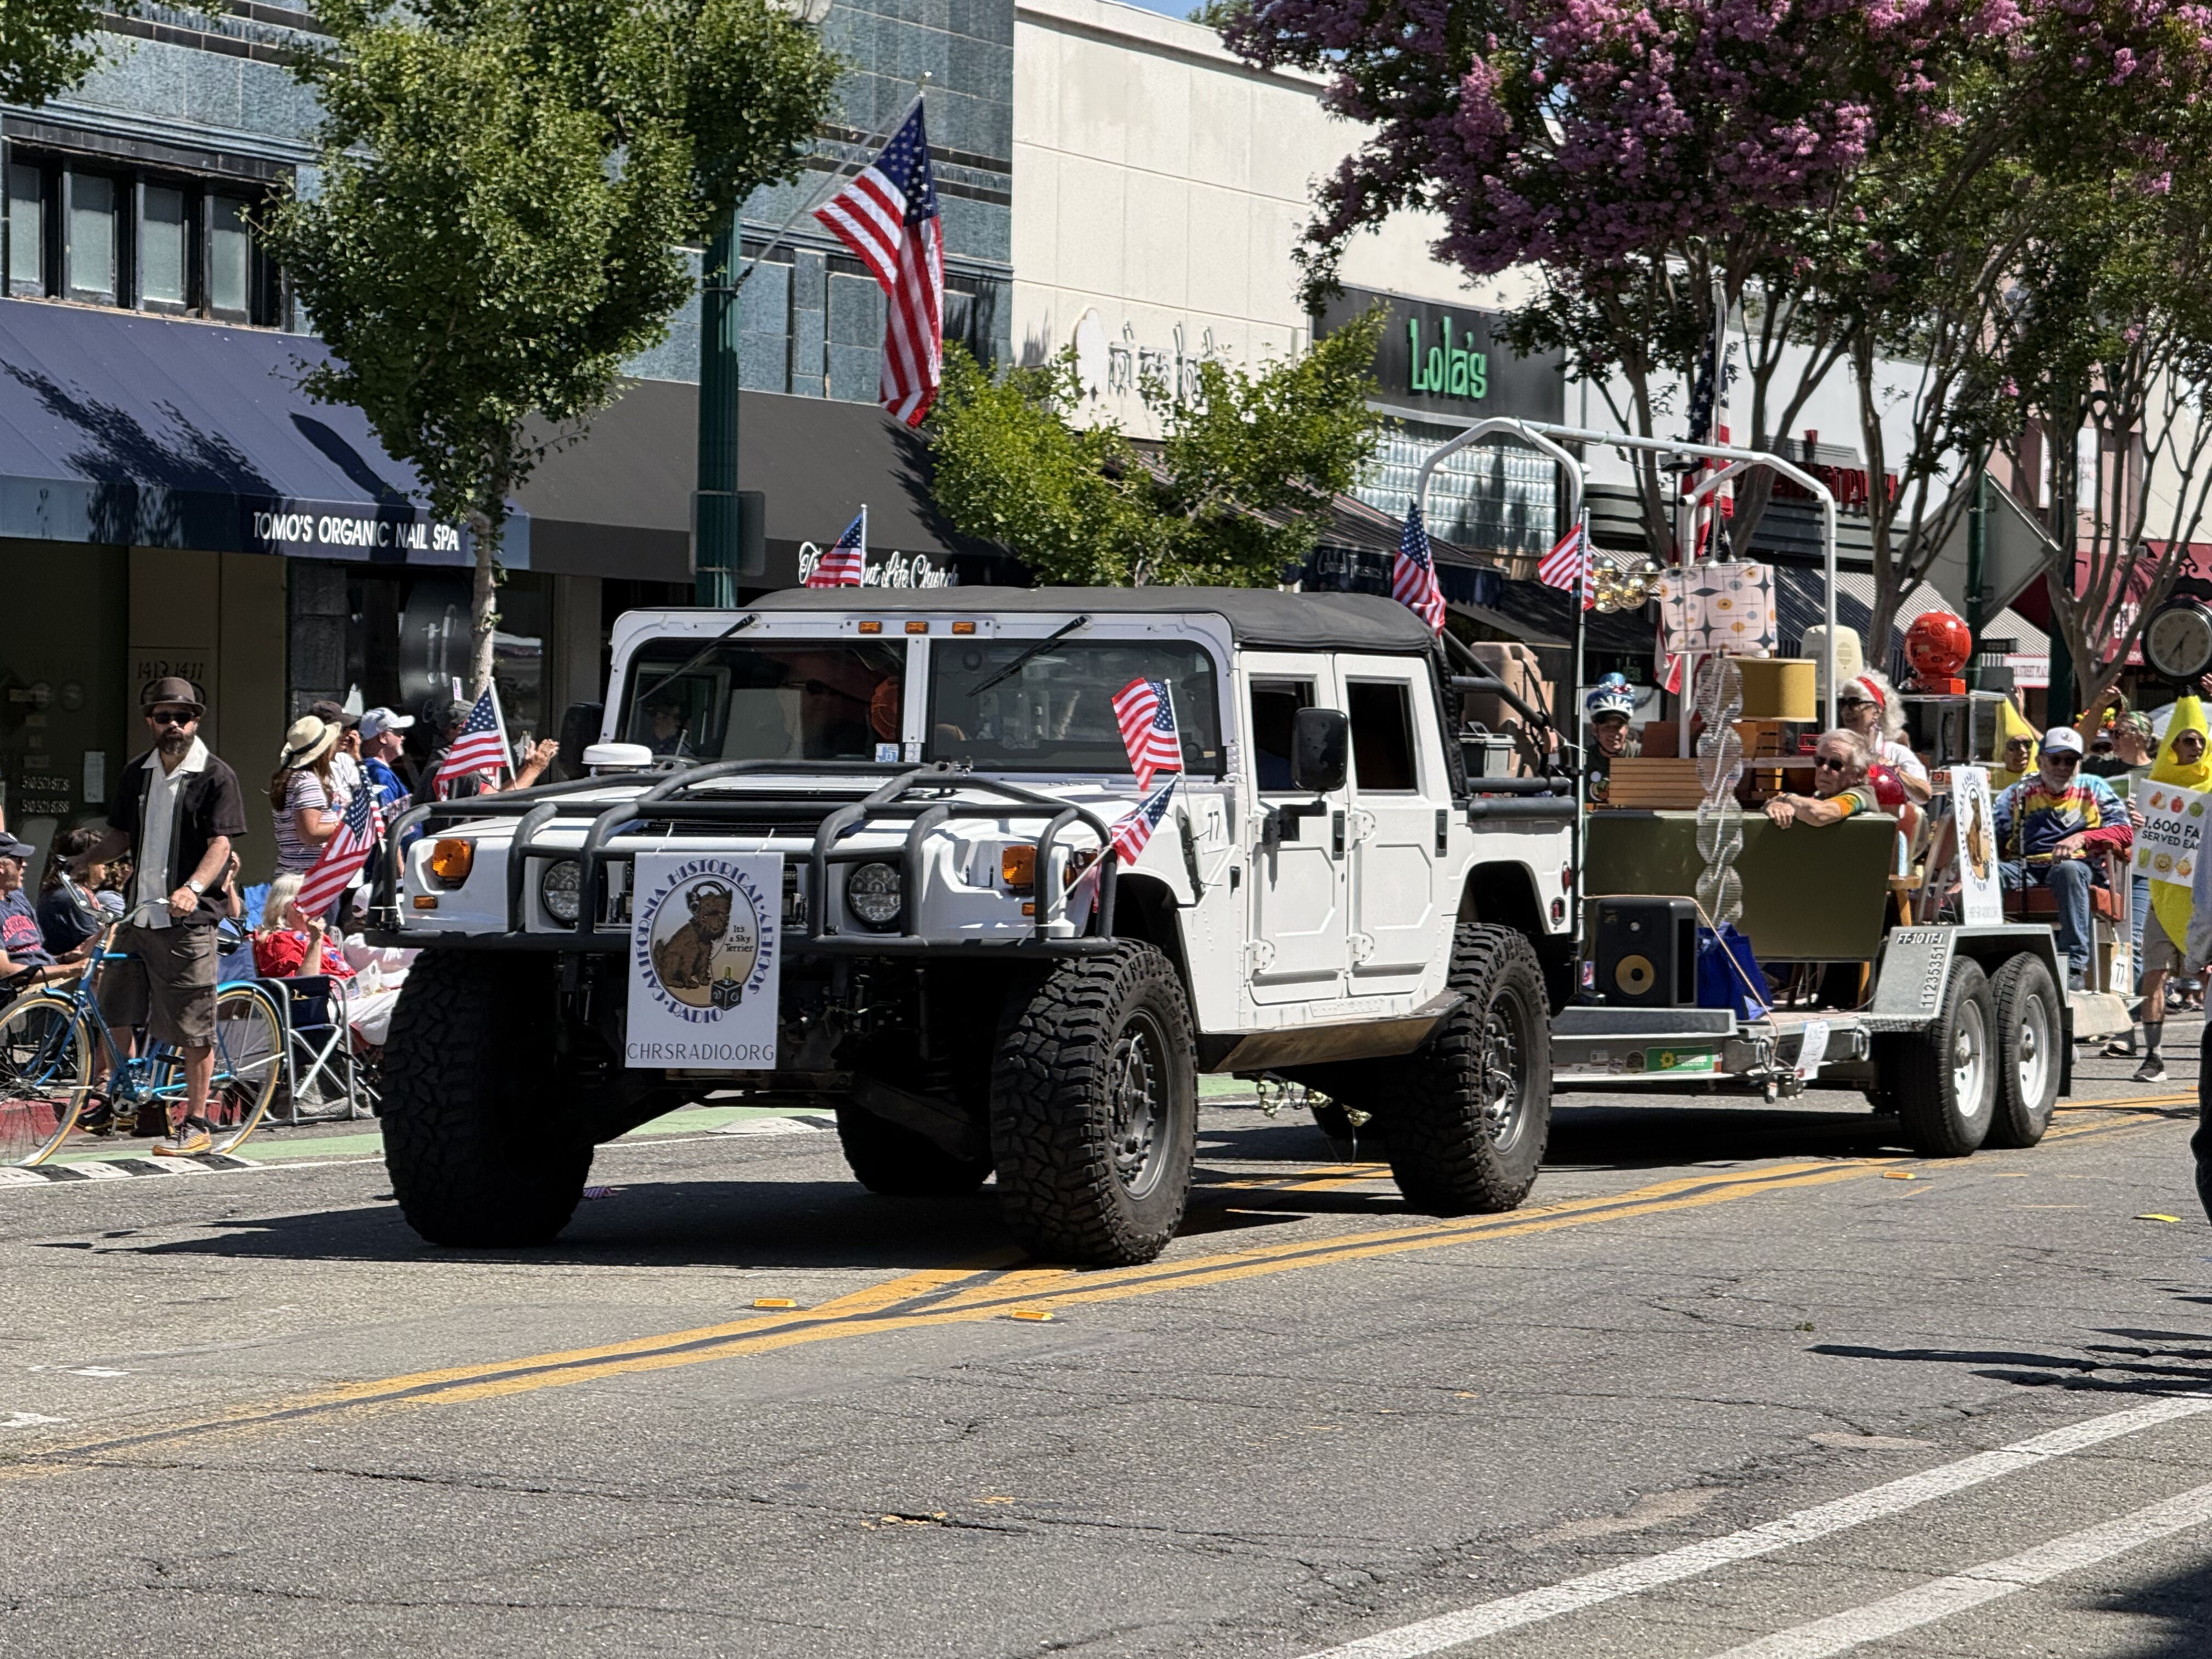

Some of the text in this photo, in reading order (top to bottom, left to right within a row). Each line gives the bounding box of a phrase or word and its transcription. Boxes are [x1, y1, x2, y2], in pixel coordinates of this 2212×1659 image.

[1410, 317, 1487, 398] Lola's
[253, 512, 460, 551] TOMO'S ORGANIC NAIL SPA
[1208, 810, 1220, 842] 77
[2142, 830, 2181, 846] SERVED
[2145, 816, 2181, 834] 1,600
[636, 859, 764, 1002] CALIFORNIA HISTORICAL
[735, 934, 751, 944] Sky
[725, 943, 754, 952] Terrier
[667, 911, 774, 1024] RADIO SOCIETY
[1922, 946, 1945, 1007] 11235351
[2115, 962, 2125, 984] 77
[627, 1042, 774, 1061] CHRSRADIO.ORG
